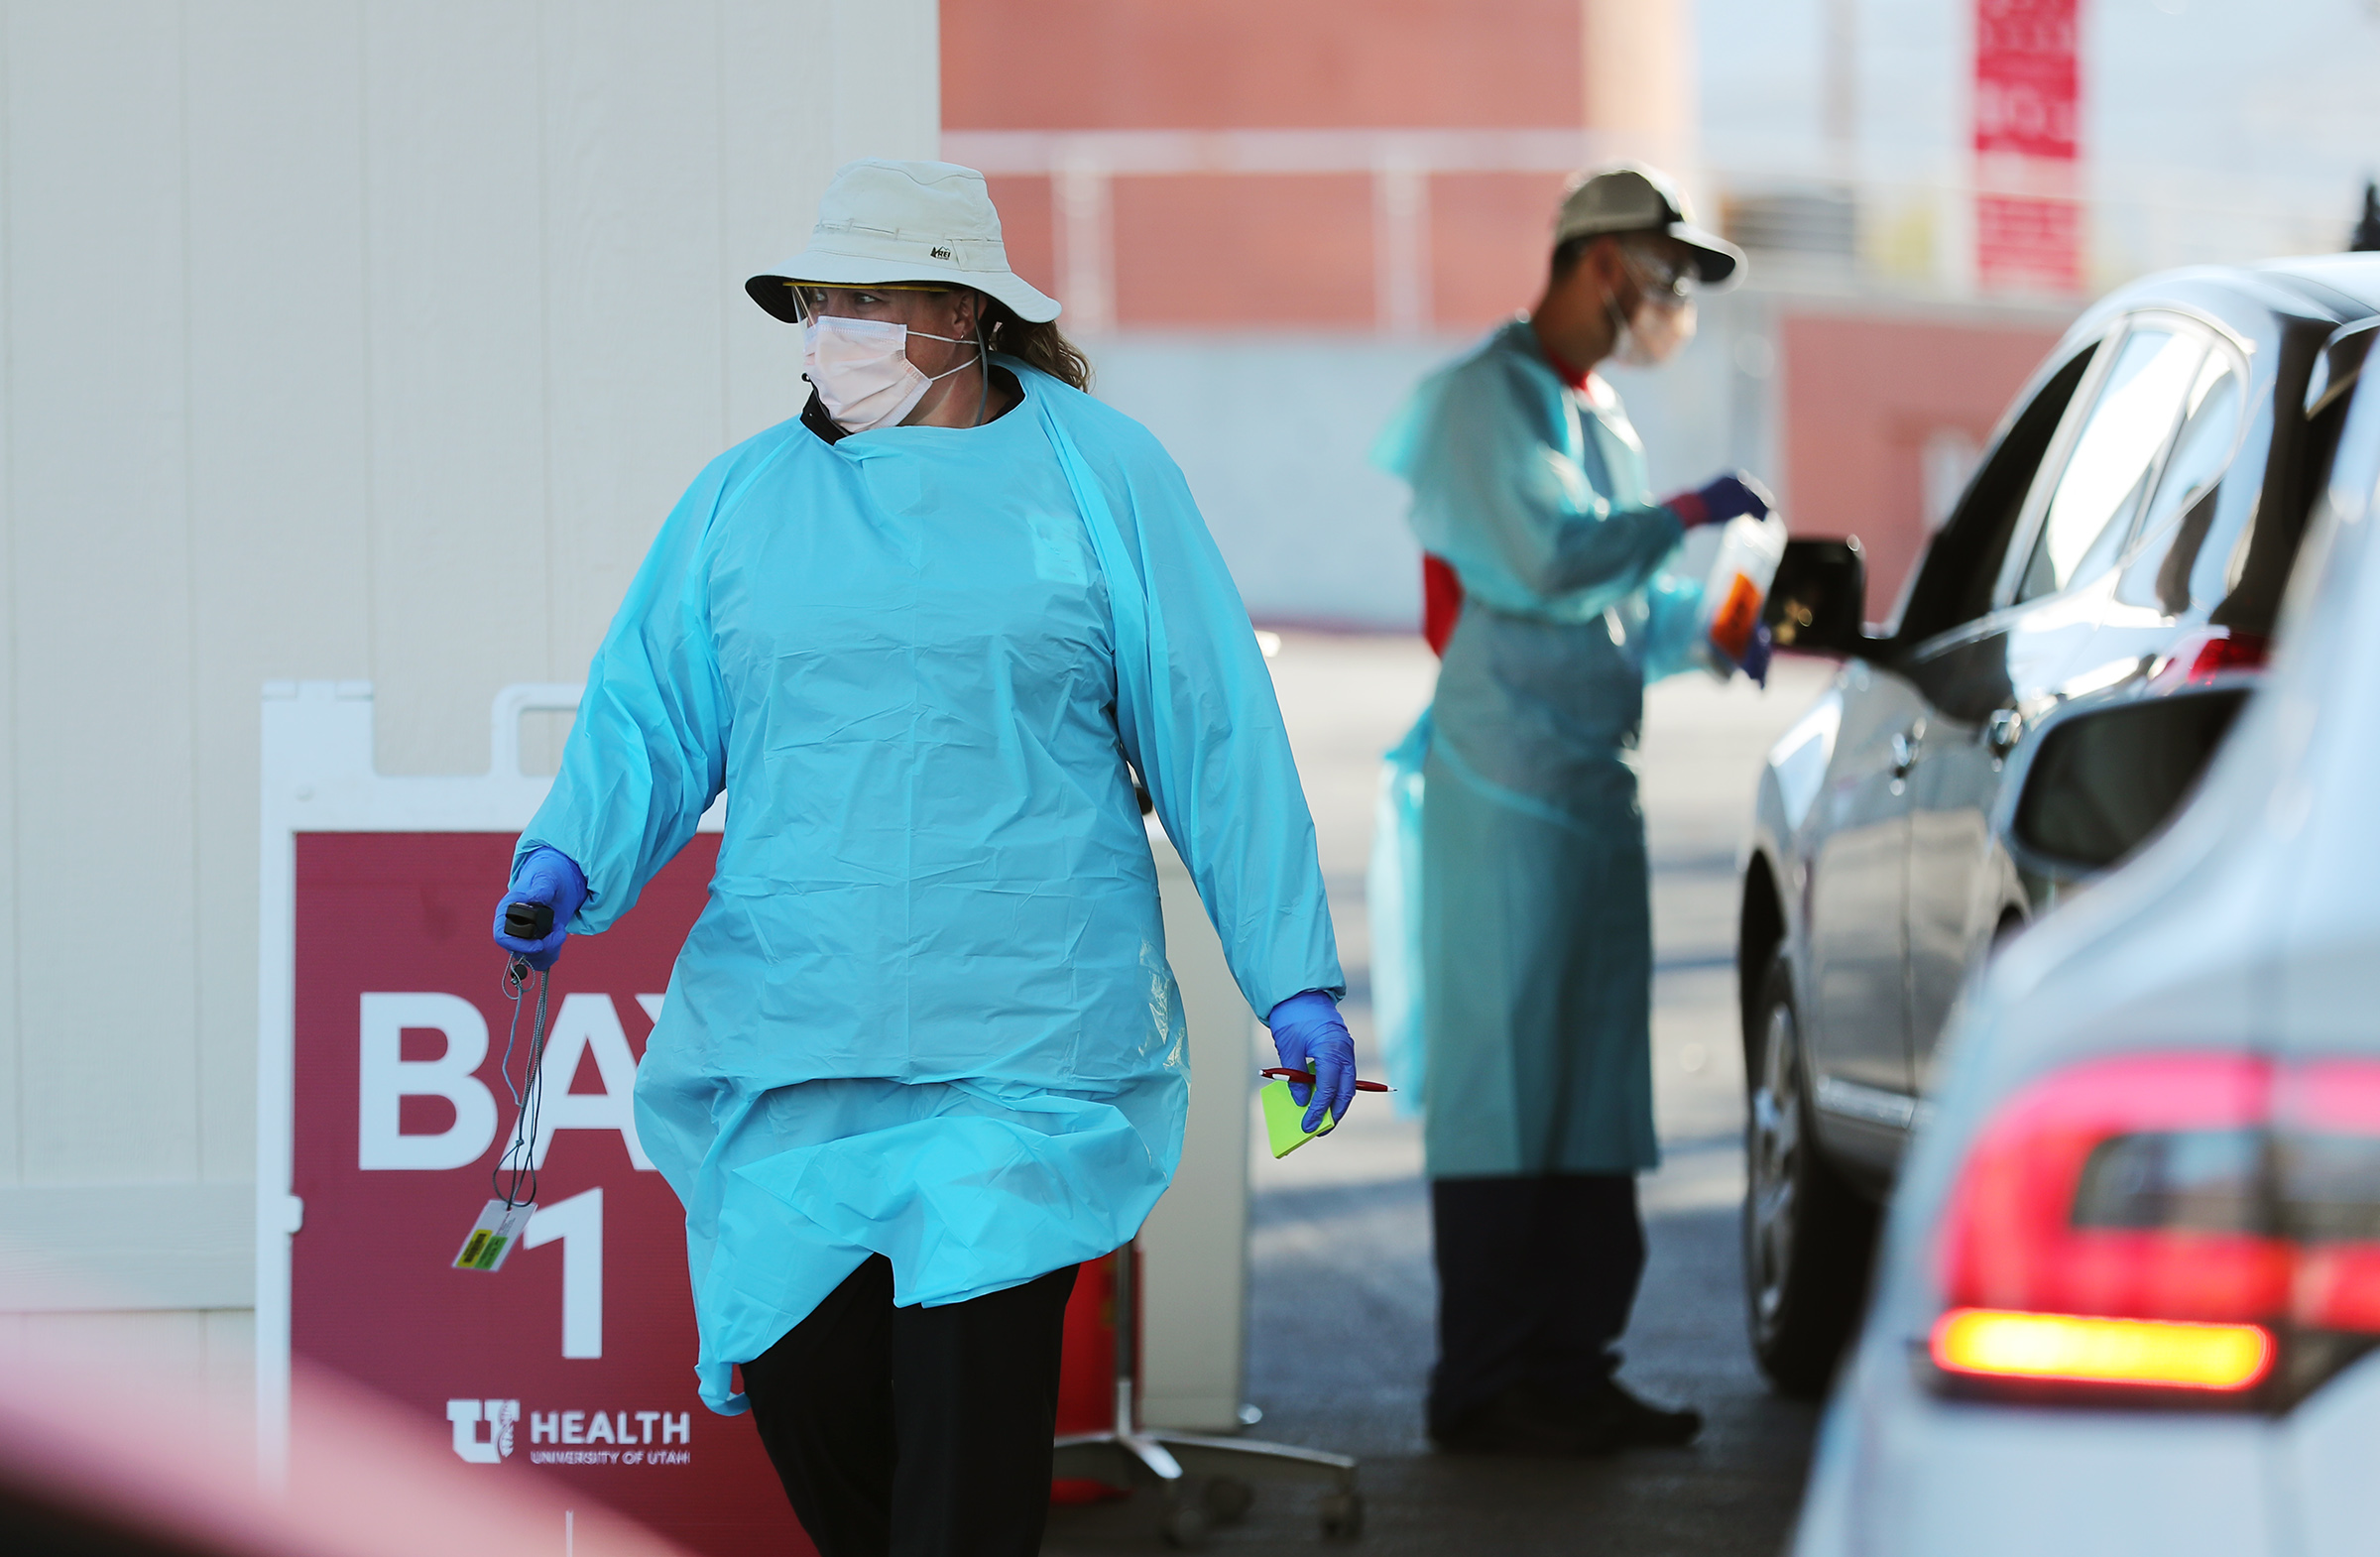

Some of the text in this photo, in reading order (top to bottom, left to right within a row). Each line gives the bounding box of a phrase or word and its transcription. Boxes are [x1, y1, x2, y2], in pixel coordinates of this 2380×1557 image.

[523, 1186, 603, 1360] 1
[531, 1411, 691, 1445] HEALTH
[531, 1451, 691, 1466] UNIVERSITY OF UTAH
